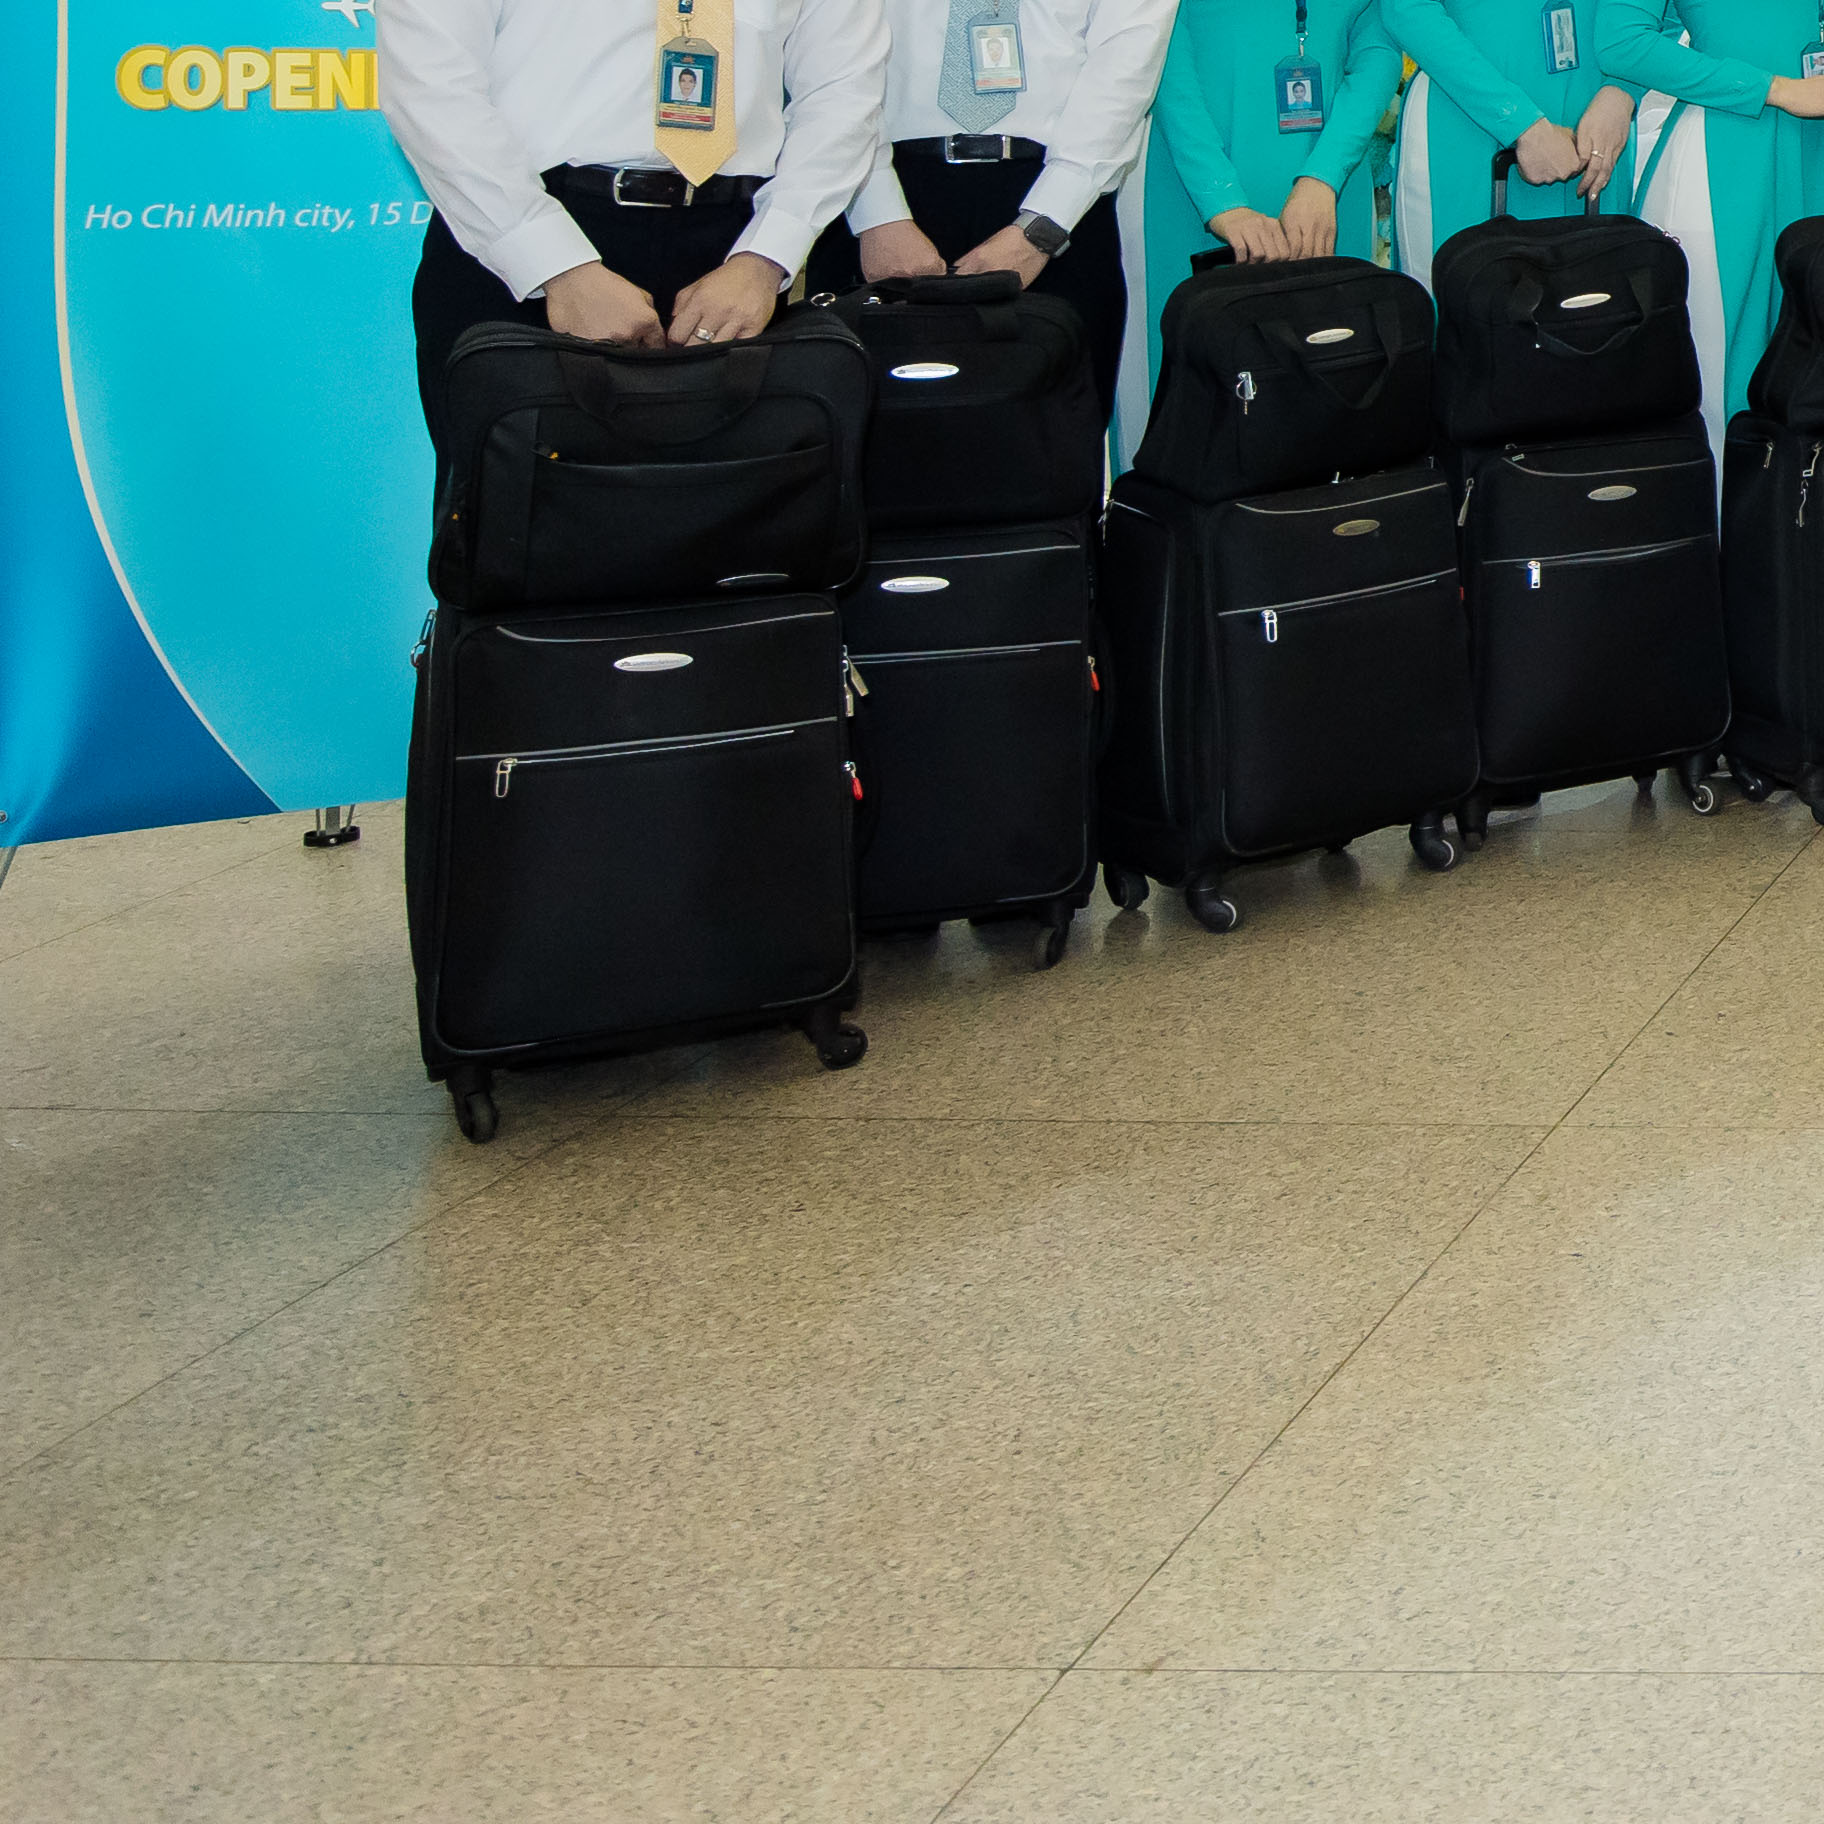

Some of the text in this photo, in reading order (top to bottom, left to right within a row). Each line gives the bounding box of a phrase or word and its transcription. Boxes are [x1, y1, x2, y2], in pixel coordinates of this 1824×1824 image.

[115, 44, 380, 111] COPEN
[86, 204, 133, 229] Ho
[141, 203, 196, 229] Chi
[203, 203, 286, 229] Minh
[294, 203, 354, 232] city,
[368, 202, 402, 227] 15
